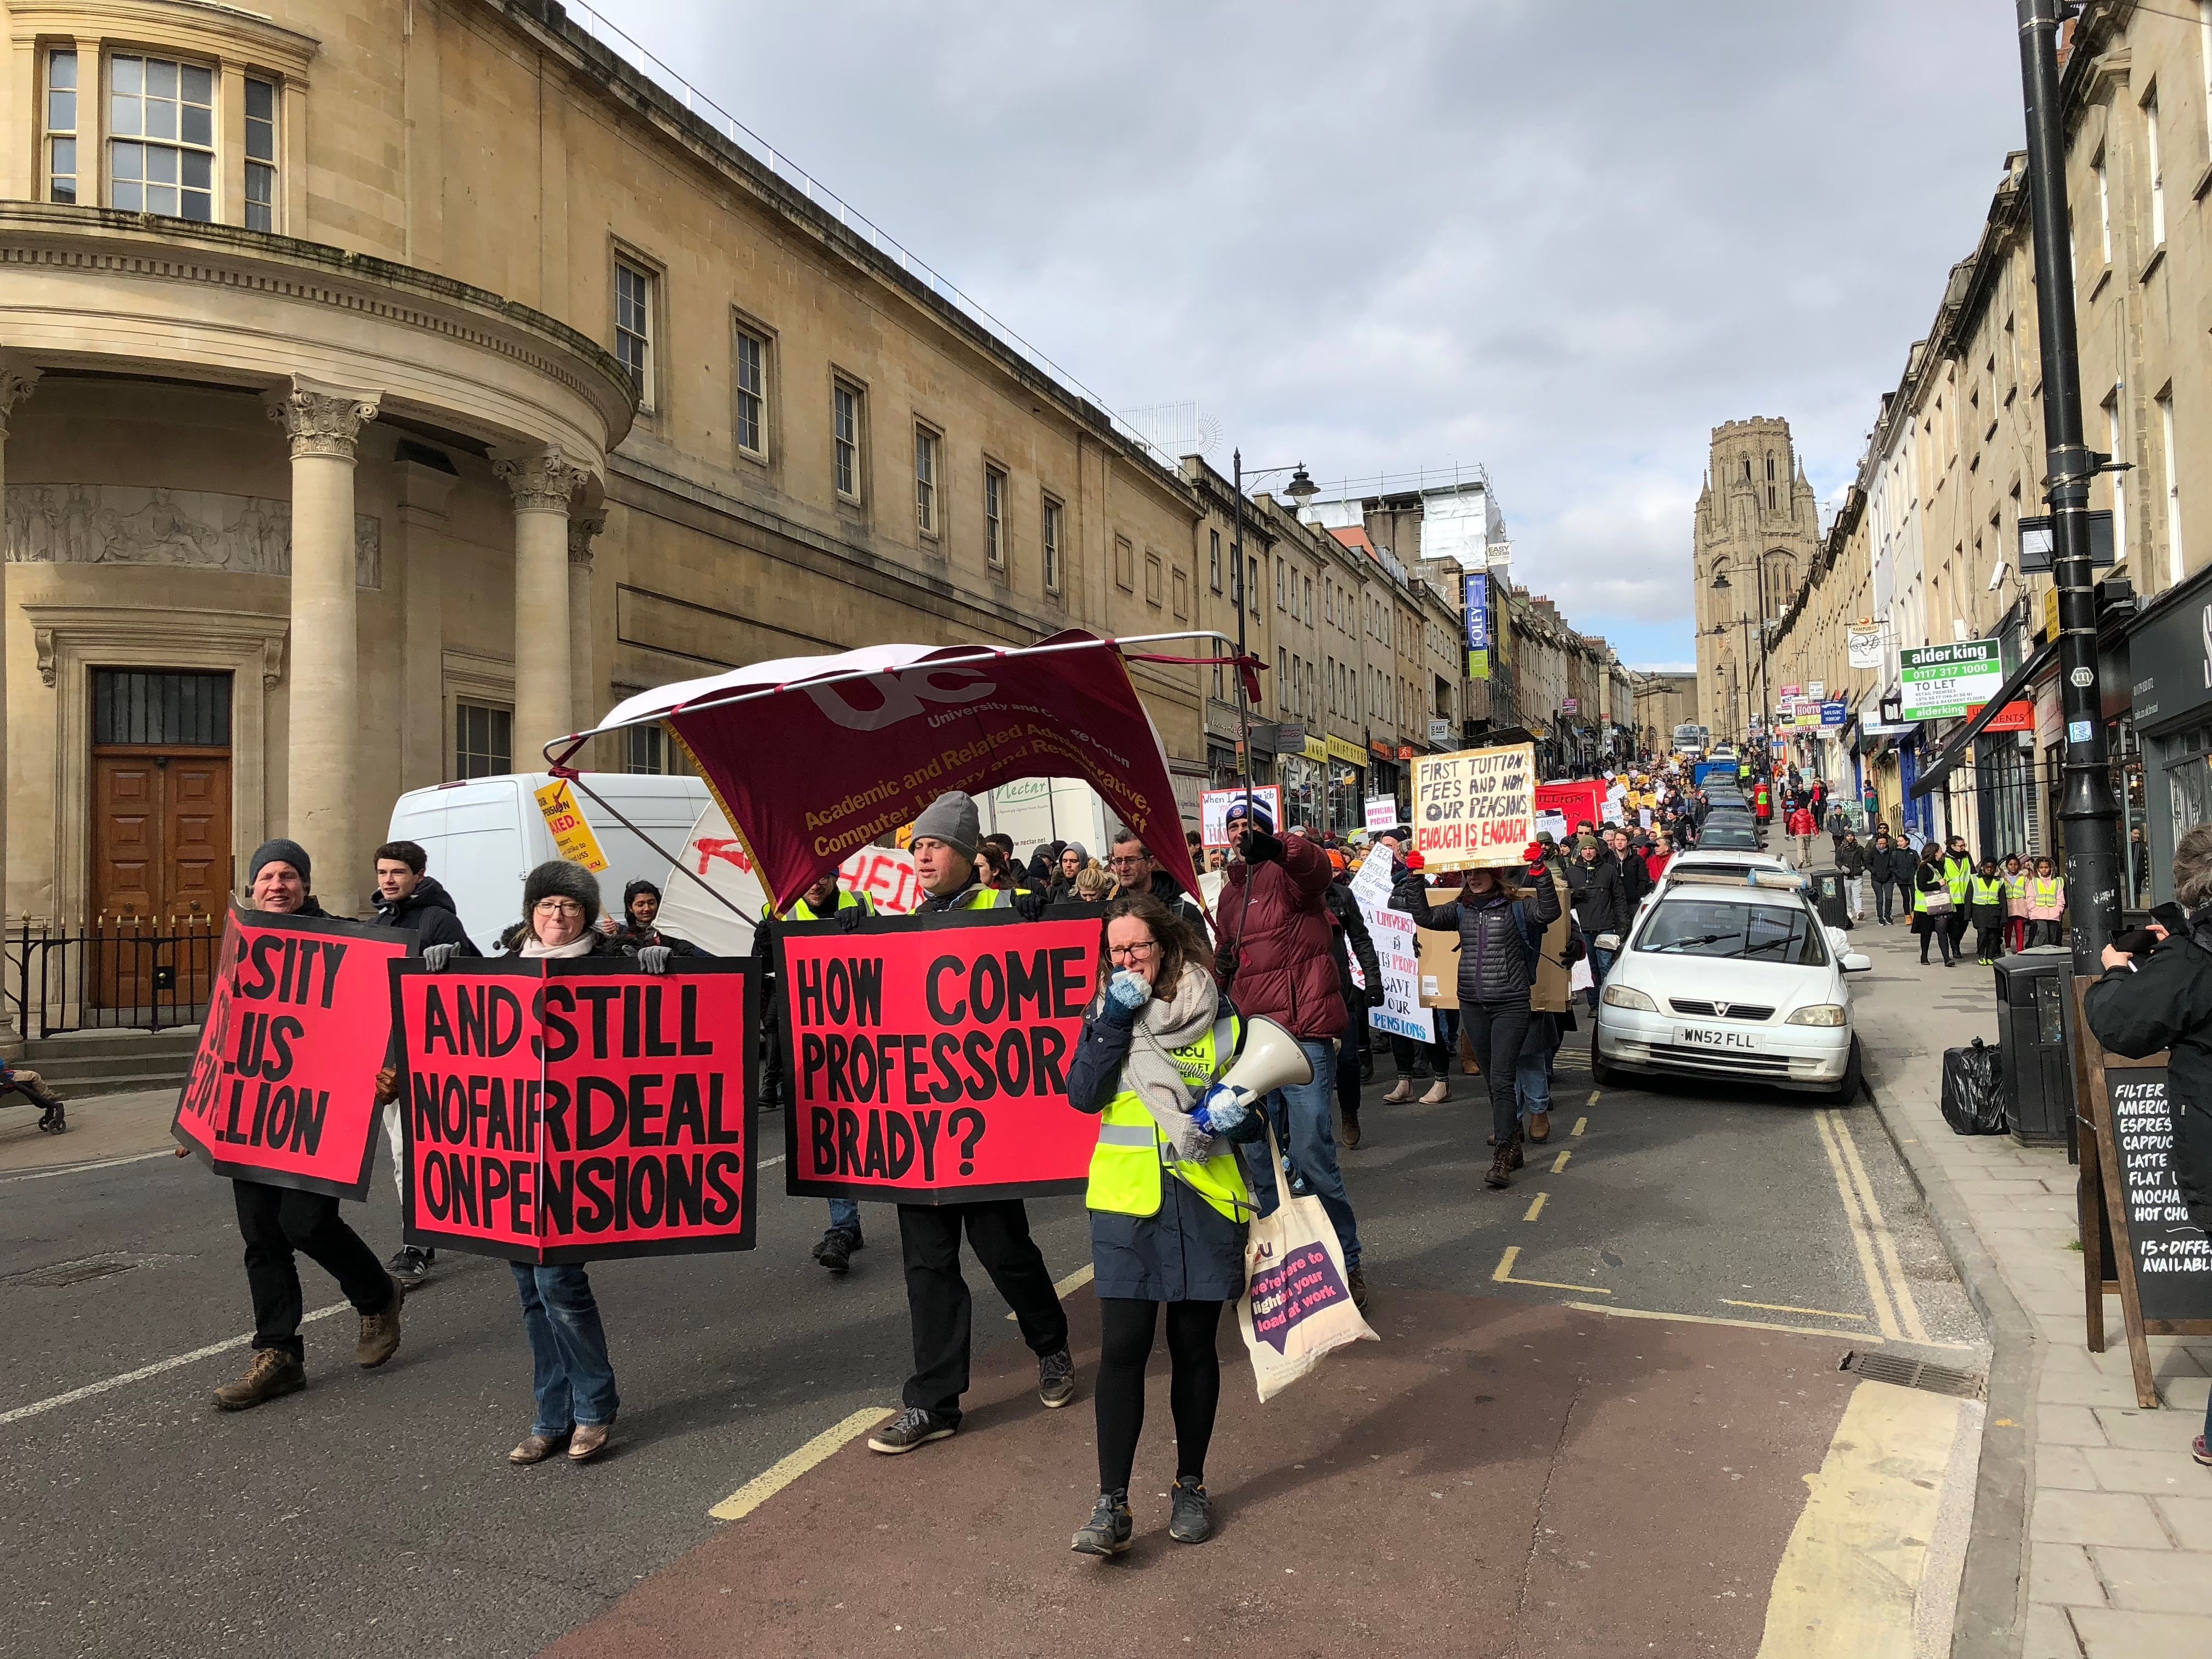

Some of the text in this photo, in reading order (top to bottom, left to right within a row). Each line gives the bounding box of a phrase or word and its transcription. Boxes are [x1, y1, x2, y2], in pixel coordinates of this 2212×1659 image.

[1471, 607, 1483, 647] FOLEY
[1912, 645, 1987, 664] alder king
[1913, 664, 1988, 679] 0117 317 1000
[1915, 679, 1956, 691] TO LET
[927, 702, 1007, 728] University
[1012, 703, 1039, 713] and
[1797, 705, 1820, 715] HOOTO
[1916, 705, 1966, 716] alderking.
[1993, 714, 2024, 723] DENTS
[1307, 741, 1323, 757] TAGE
[1330, 739, 1348, 757] THRIFT
[1350, 749, 1366, 764] STORE
[1421, 753, 1524, 782] FIRST TUITION
[805, 780, 900, 831] Academic
[904, 763, 943, 789] and
[941, 725, 1023, 770] Related
[914, 768, 986, 810] Library
[991, 746, 1028, 771] and
[1420, 780, 1462, 802] FEES
[1470, 776, 1496, 795] AND
[1203, 795, 1224, 804] When
[1426, 794, 1527, 821] OUR PENSIONS
[1367, 806, 1394, 816] OFFICIAL
[1370, 816, 1392, 826] PICKET
[1419, 819, 1527, 850] ENOUGH IS ENOUGH
[577, 851, 589, 860] USS
[1359, 870, 1373, 883] USS
[1365, 859, 1389, 878] ARTICLE
[1365, 910, 1414, 934] A UNIVERSI
[1392, 954, 1418, 976] PEOPL
[797, 946, 1086, 1027] HOW COME
[1384, 977, 1410, 998] SAVE
[1388, 998, 1410, 1015] OUR
[425, 984, 713, 1063] AND STILL
[1373, 1013, 1426, 1040] PENSIONS
[1685, 1029, 1754, 1048] WN52 FLL
[802, 1026, 1068, 1104] PROFESSOR
[2115, 1083, 2164, 1098] FILTER
[2120, 1117, 2172, 1133] ESPRES
[811, 1107, 985, 1182] BRADY?
[2123, 1135, 2174, 1151] CAPPUC
[2127, 1153, 2168, 1169] LATTE
[2129, 1171, 2164, 1186] FLAT
[2131, 1189, 2180, 1205] MOCHA
[2135, 1207, 2188, 1222] HOT CHO
[1280, 1259, 1306, 1283] here
[1308, 1252, 1324, 1265] to
[2143, 1257, 2212, 1273] AVAILABL
[1294, 1271, 1323, 1295] your
[1257, 1285, 1336, 1333] load at work
